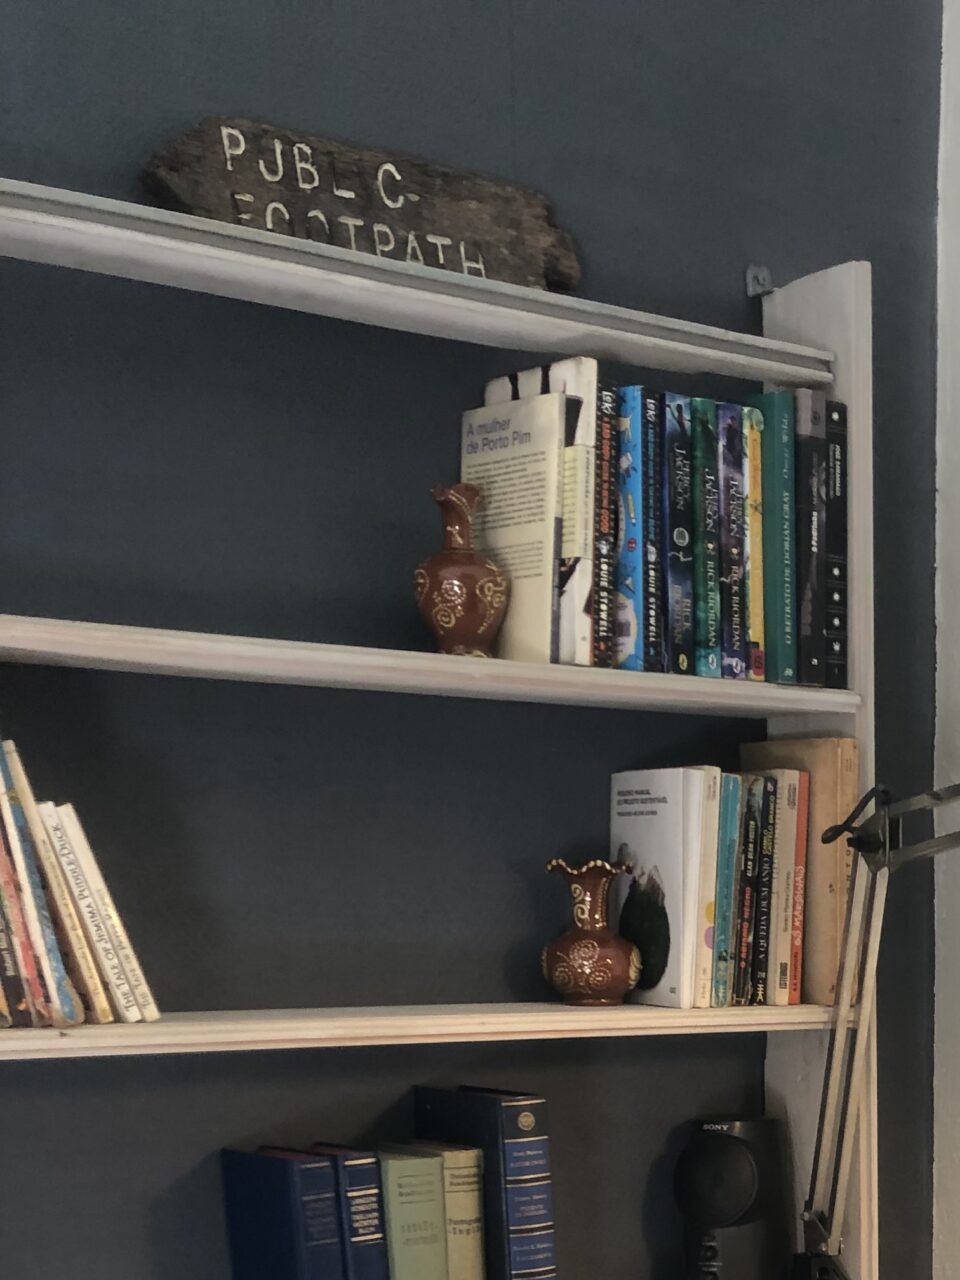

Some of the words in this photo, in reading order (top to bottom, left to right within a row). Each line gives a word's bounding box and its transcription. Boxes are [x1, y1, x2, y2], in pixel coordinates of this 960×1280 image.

[466, 441, 479, 454] de
[482, 437, 509, 452] Porto
[512, 431, 531, 446] Pim
[467, 424, 474, 438] A
[674, 442, 686, 511] JACKSON
[705, 468, 716, 532] JACKSON
[600, 558, 608, 587] LOUIE
[707, 561, 715, 590] RICK
[783, 567, 791, 582] DE
[600, 591, 608, 636] STOWELL
[648, 597, 656, 642] STOWELL
[707, 592, 717, 647] RIORDAN
[783, 583, 791, 633] RETRATO
[732, 596, 740, 650] RIORDAN
[762, 857, 770, 882] ANJO
[761, 887, 769, 912] DUM
[86, 901, 108, 943] JEMIMA
[759, 915, 768, 951] QUEDA
[100, 939, 115, 961] OF
[110, 962, 126, 990] TALE
[123, 988, 135, 1011] THE
[702, 1122, 729, 1132] SONY
